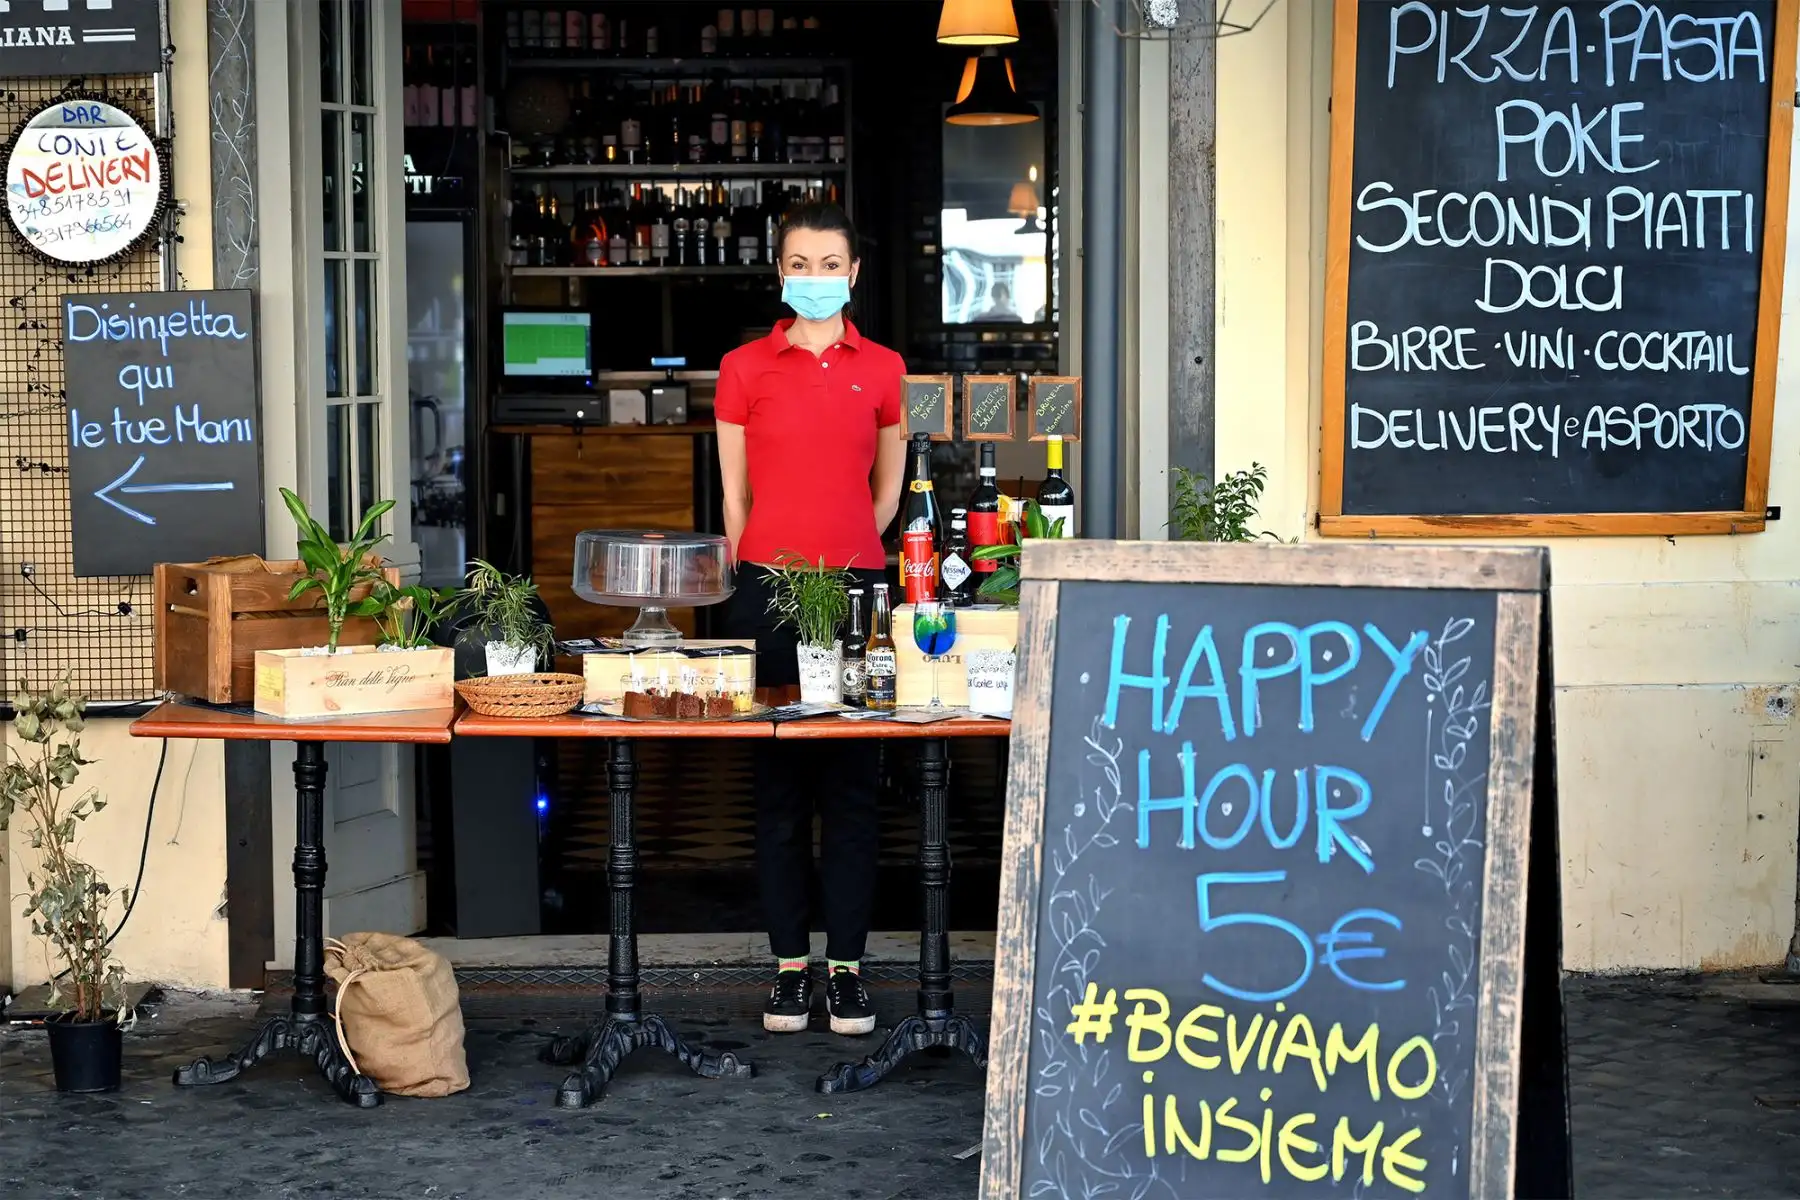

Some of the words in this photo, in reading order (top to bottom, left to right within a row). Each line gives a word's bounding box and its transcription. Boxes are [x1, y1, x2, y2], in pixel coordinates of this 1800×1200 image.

[1388, 1, 1579, 89] PIZZA
[1599, 0, 1766, 87] PASTA
[62, 105, 107, 124] DAR
[1496, 100, 1660, 182] POKE
[21, 148, 150, 198] DELIVERY
[1356, 181, 1592, 252] SECONDI
[1606, 186, 1754, 253] PIATTI
[1475, 257, 1623, 313] DOLCI
[67, 300, 248, 356] Disinfetta
[1351, 320, 1486, 373] BIRRE
[1505, 327, 1576, 371] VINI
[1594, 330, 1749, 375] COCKTAIL
[118, 364, 174, 406] qui
[72, 408, 105, 448] le
[112, 406, 171, 444] tue
[175, 403, 252, 443] Mani
[1351, 402, 1561, 458] DELIVERY
[1581, 402, 1745, 451] ASPORTO
[1102, 613, 1429, 741] HAPPY
[1136, 741, 1376, 875] HOUR
